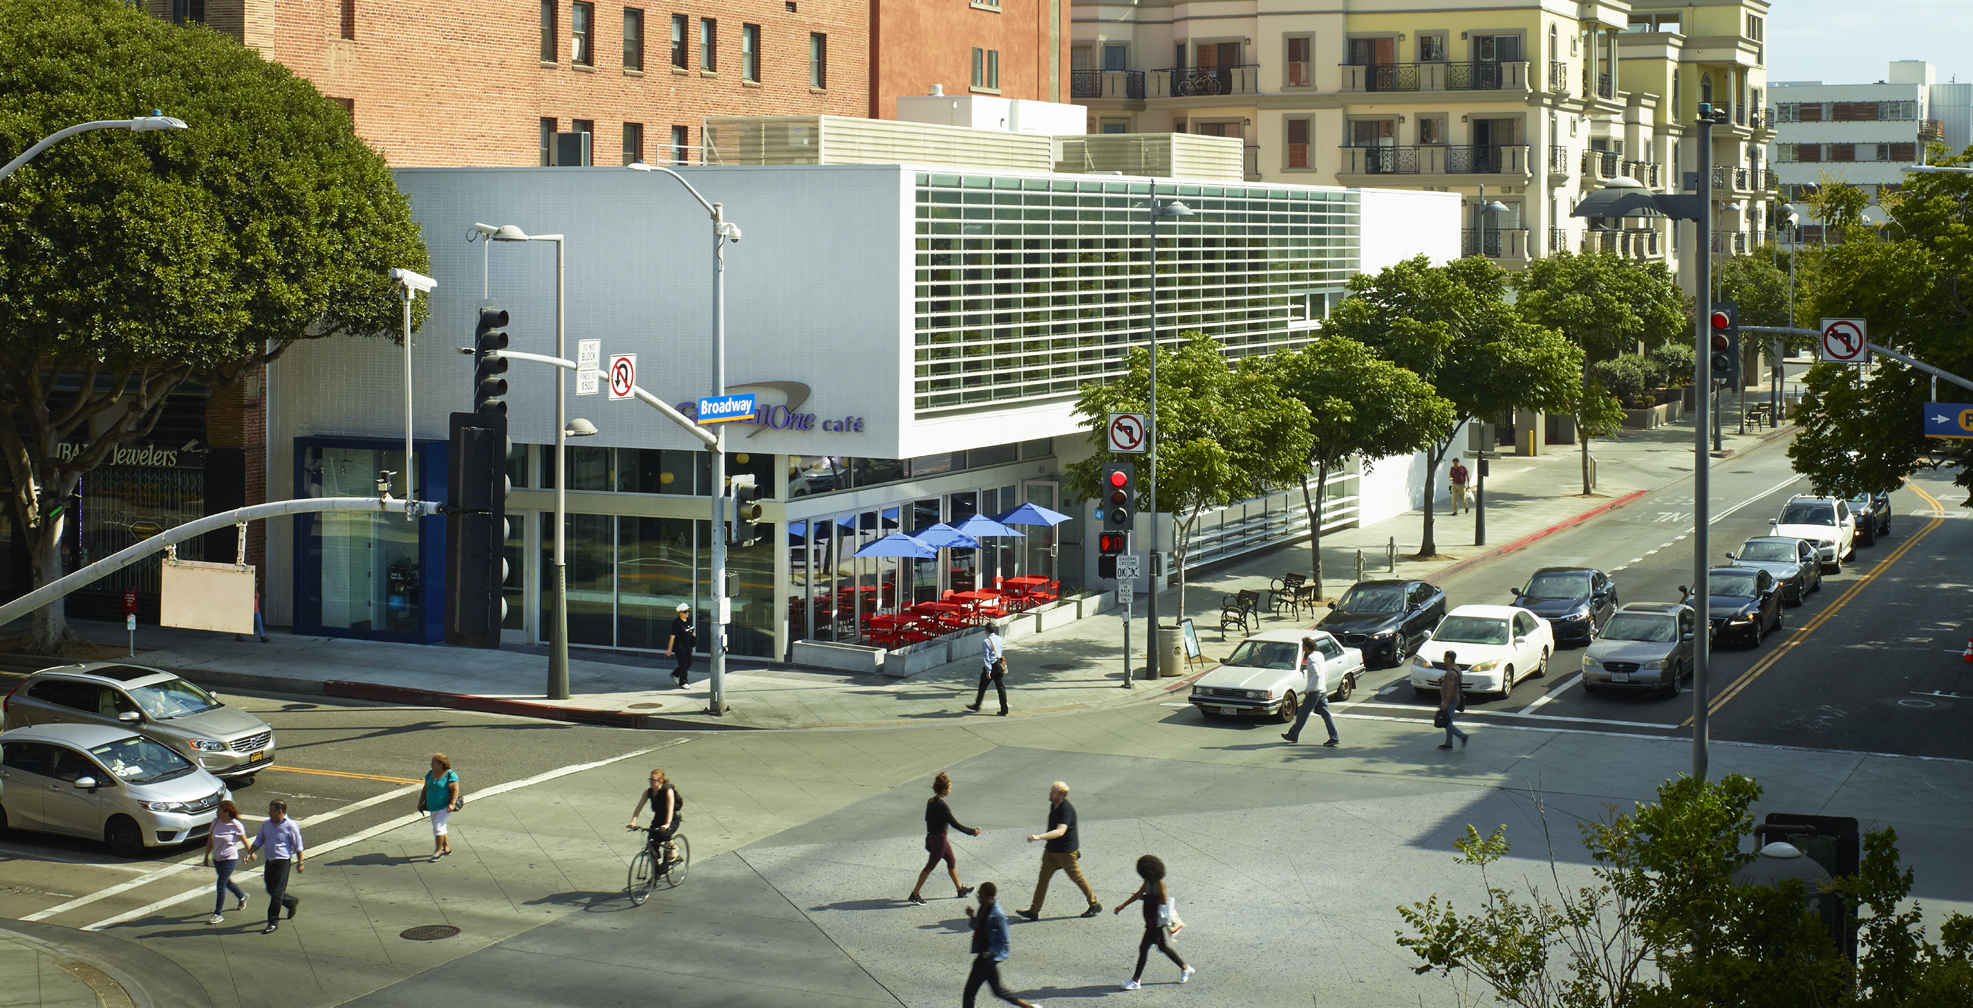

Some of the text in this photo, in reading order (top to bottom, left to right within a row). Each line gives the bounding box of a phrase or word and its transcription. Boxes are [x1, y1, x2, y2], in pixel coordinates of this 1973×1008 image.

[582, 352, 596, 361] BLOCK
[582, 381, 594, 391] $500
[701, 397, 753, 415] Broadway
[822, 416, 864, 433] café
[110, 442, 178, 467] Jewelers
[1118, 568, 1127, 577] OK
